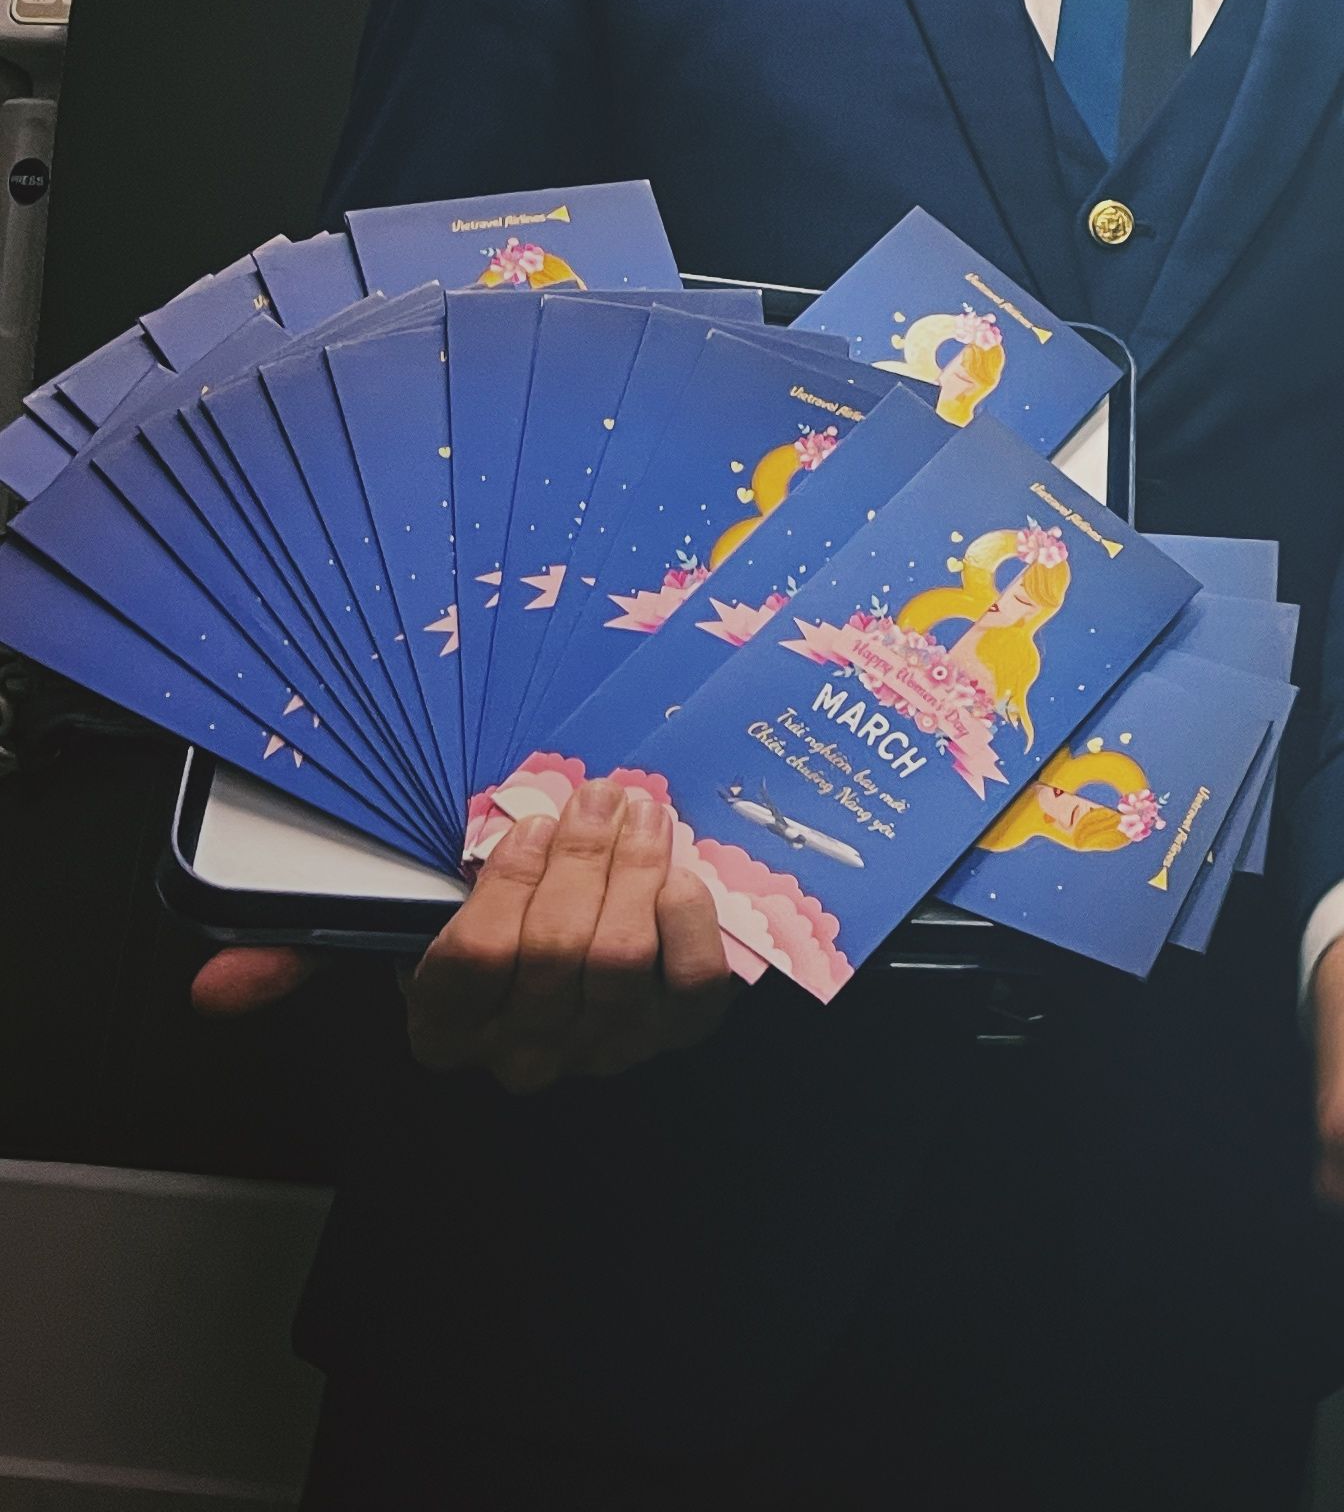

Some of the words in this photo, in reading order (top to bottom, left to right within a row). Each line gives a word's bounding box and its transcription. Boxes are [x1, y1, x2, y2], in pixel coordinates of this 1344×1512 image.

[811, 682, 928, 779] MARCH
[851, 638, 894, 676] Happy
[943, 708, 970, 738] Day
[853, 768, 880, 796] bay
